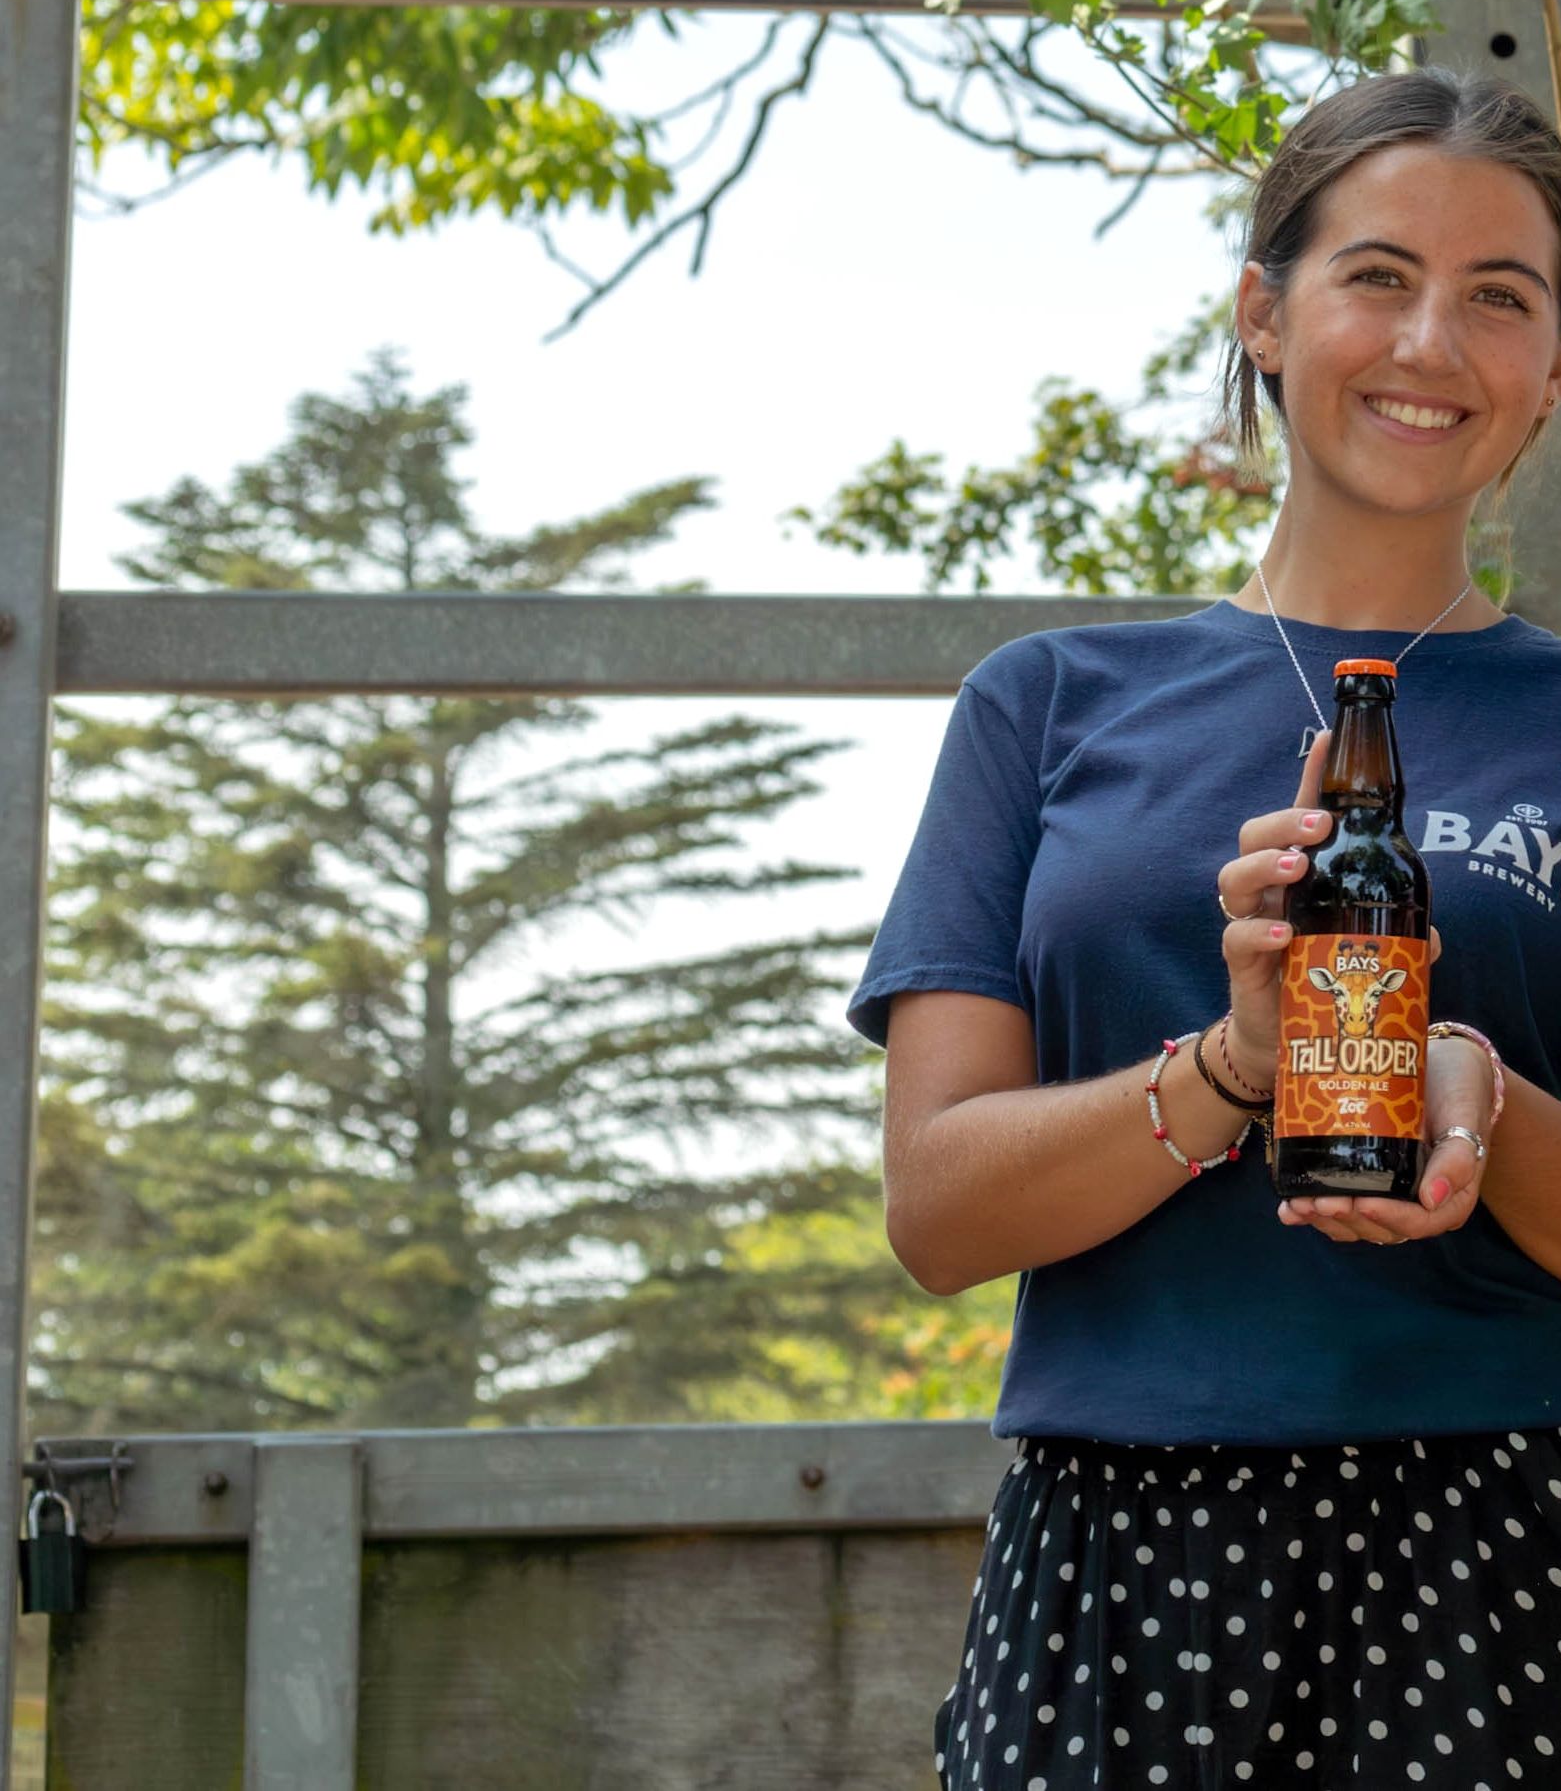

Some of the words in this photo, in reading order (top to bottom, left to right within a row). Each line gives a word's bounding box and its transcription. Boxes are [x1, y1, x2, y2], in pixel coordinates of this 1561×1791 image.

[1468, 860, 1556, 913] BREWERY
[1336, 956, 1380, 973] BAYS
[1290, 1037, 1338, 1074] TALL
[1339, 1038, 1418, 1076] ORDER
[1318, 1080, 1367, 1091] GOLDEN
[1368, 1081, 1389, 1092] ALE
